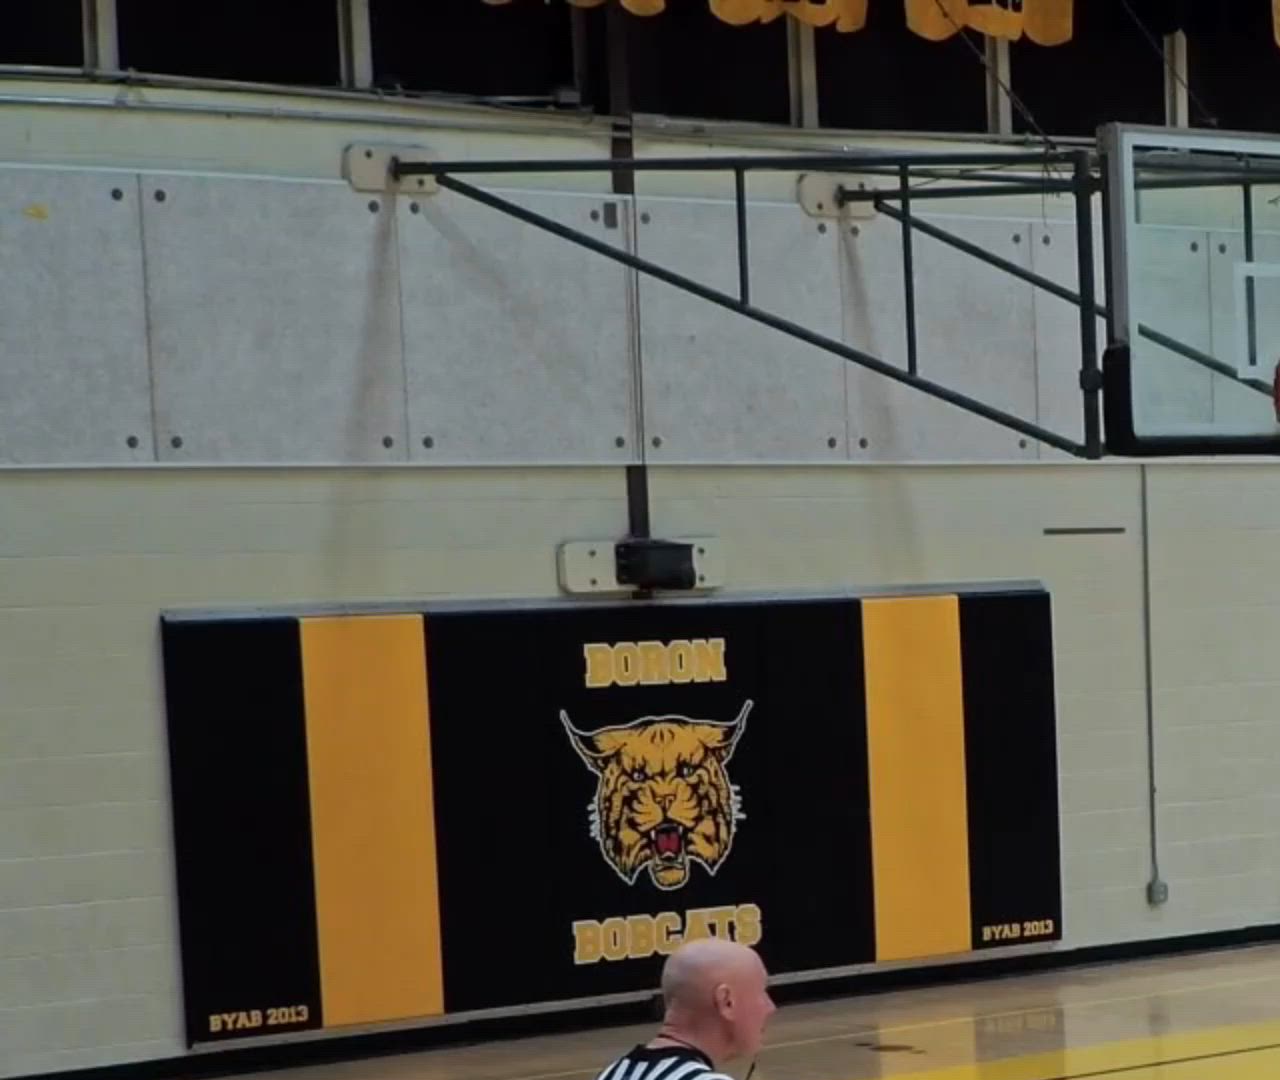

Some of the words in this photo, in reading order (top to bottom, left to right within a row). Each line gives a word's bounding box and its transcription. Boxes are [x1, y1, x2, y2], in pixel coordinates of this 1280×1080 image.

[584, 638, 727, 688] BORON
[572, 903, 763, 965] BOBCATS
[982, 923, 1021, 941] BYAB
[1023, 919, 1054, 937] 2013
[209, 1009, 263, 1032] BYAB
[266, 1004, 309, 1026] 2013
